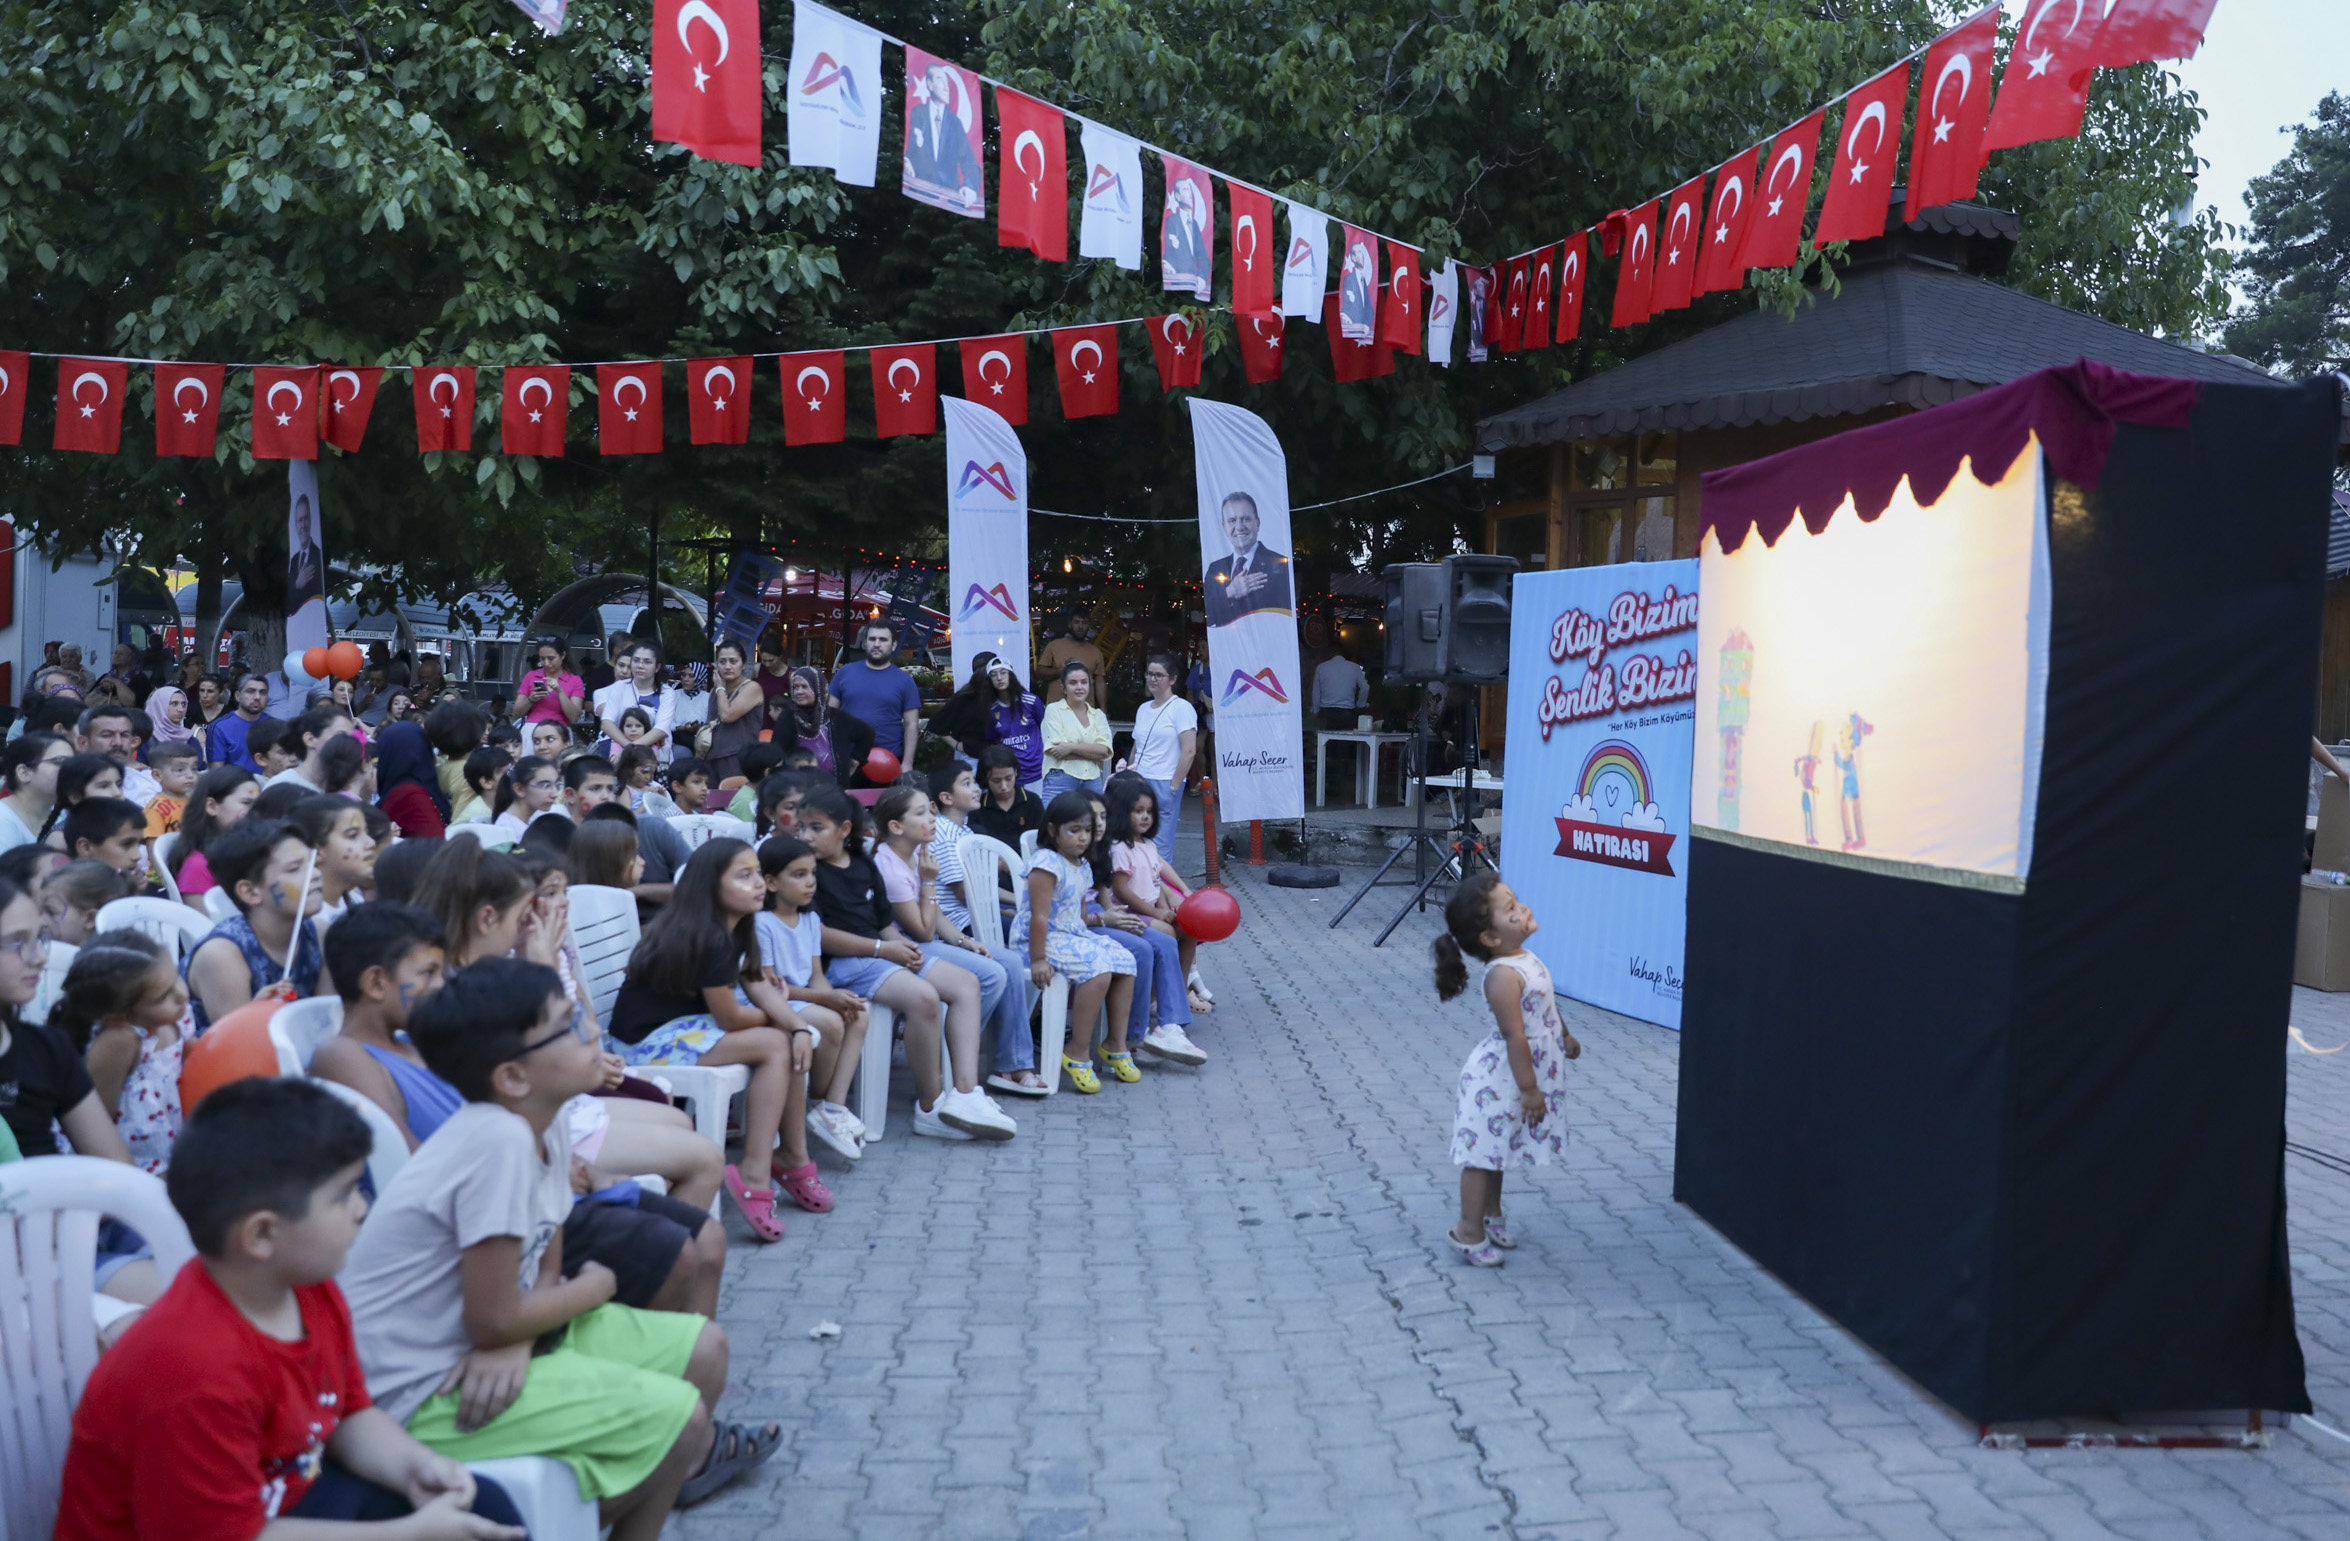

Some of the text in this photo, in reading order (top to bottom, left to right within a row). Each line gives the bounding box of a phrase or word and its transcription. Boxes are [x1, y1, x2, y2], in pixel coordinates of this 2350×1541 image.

[1550, 586, 1698, 669] Köy Bizim
[1539, 664, 1615, 738] Şenlik
[1624, 719, 1637, 730] Köy
[1639, 716, 1659, 727] Bizim
[1222, 751, 1257, 773] Vahap
[1573, 829, 1649, 863] HATIRASI
[1629, 955, 1663, 993] Vahap
